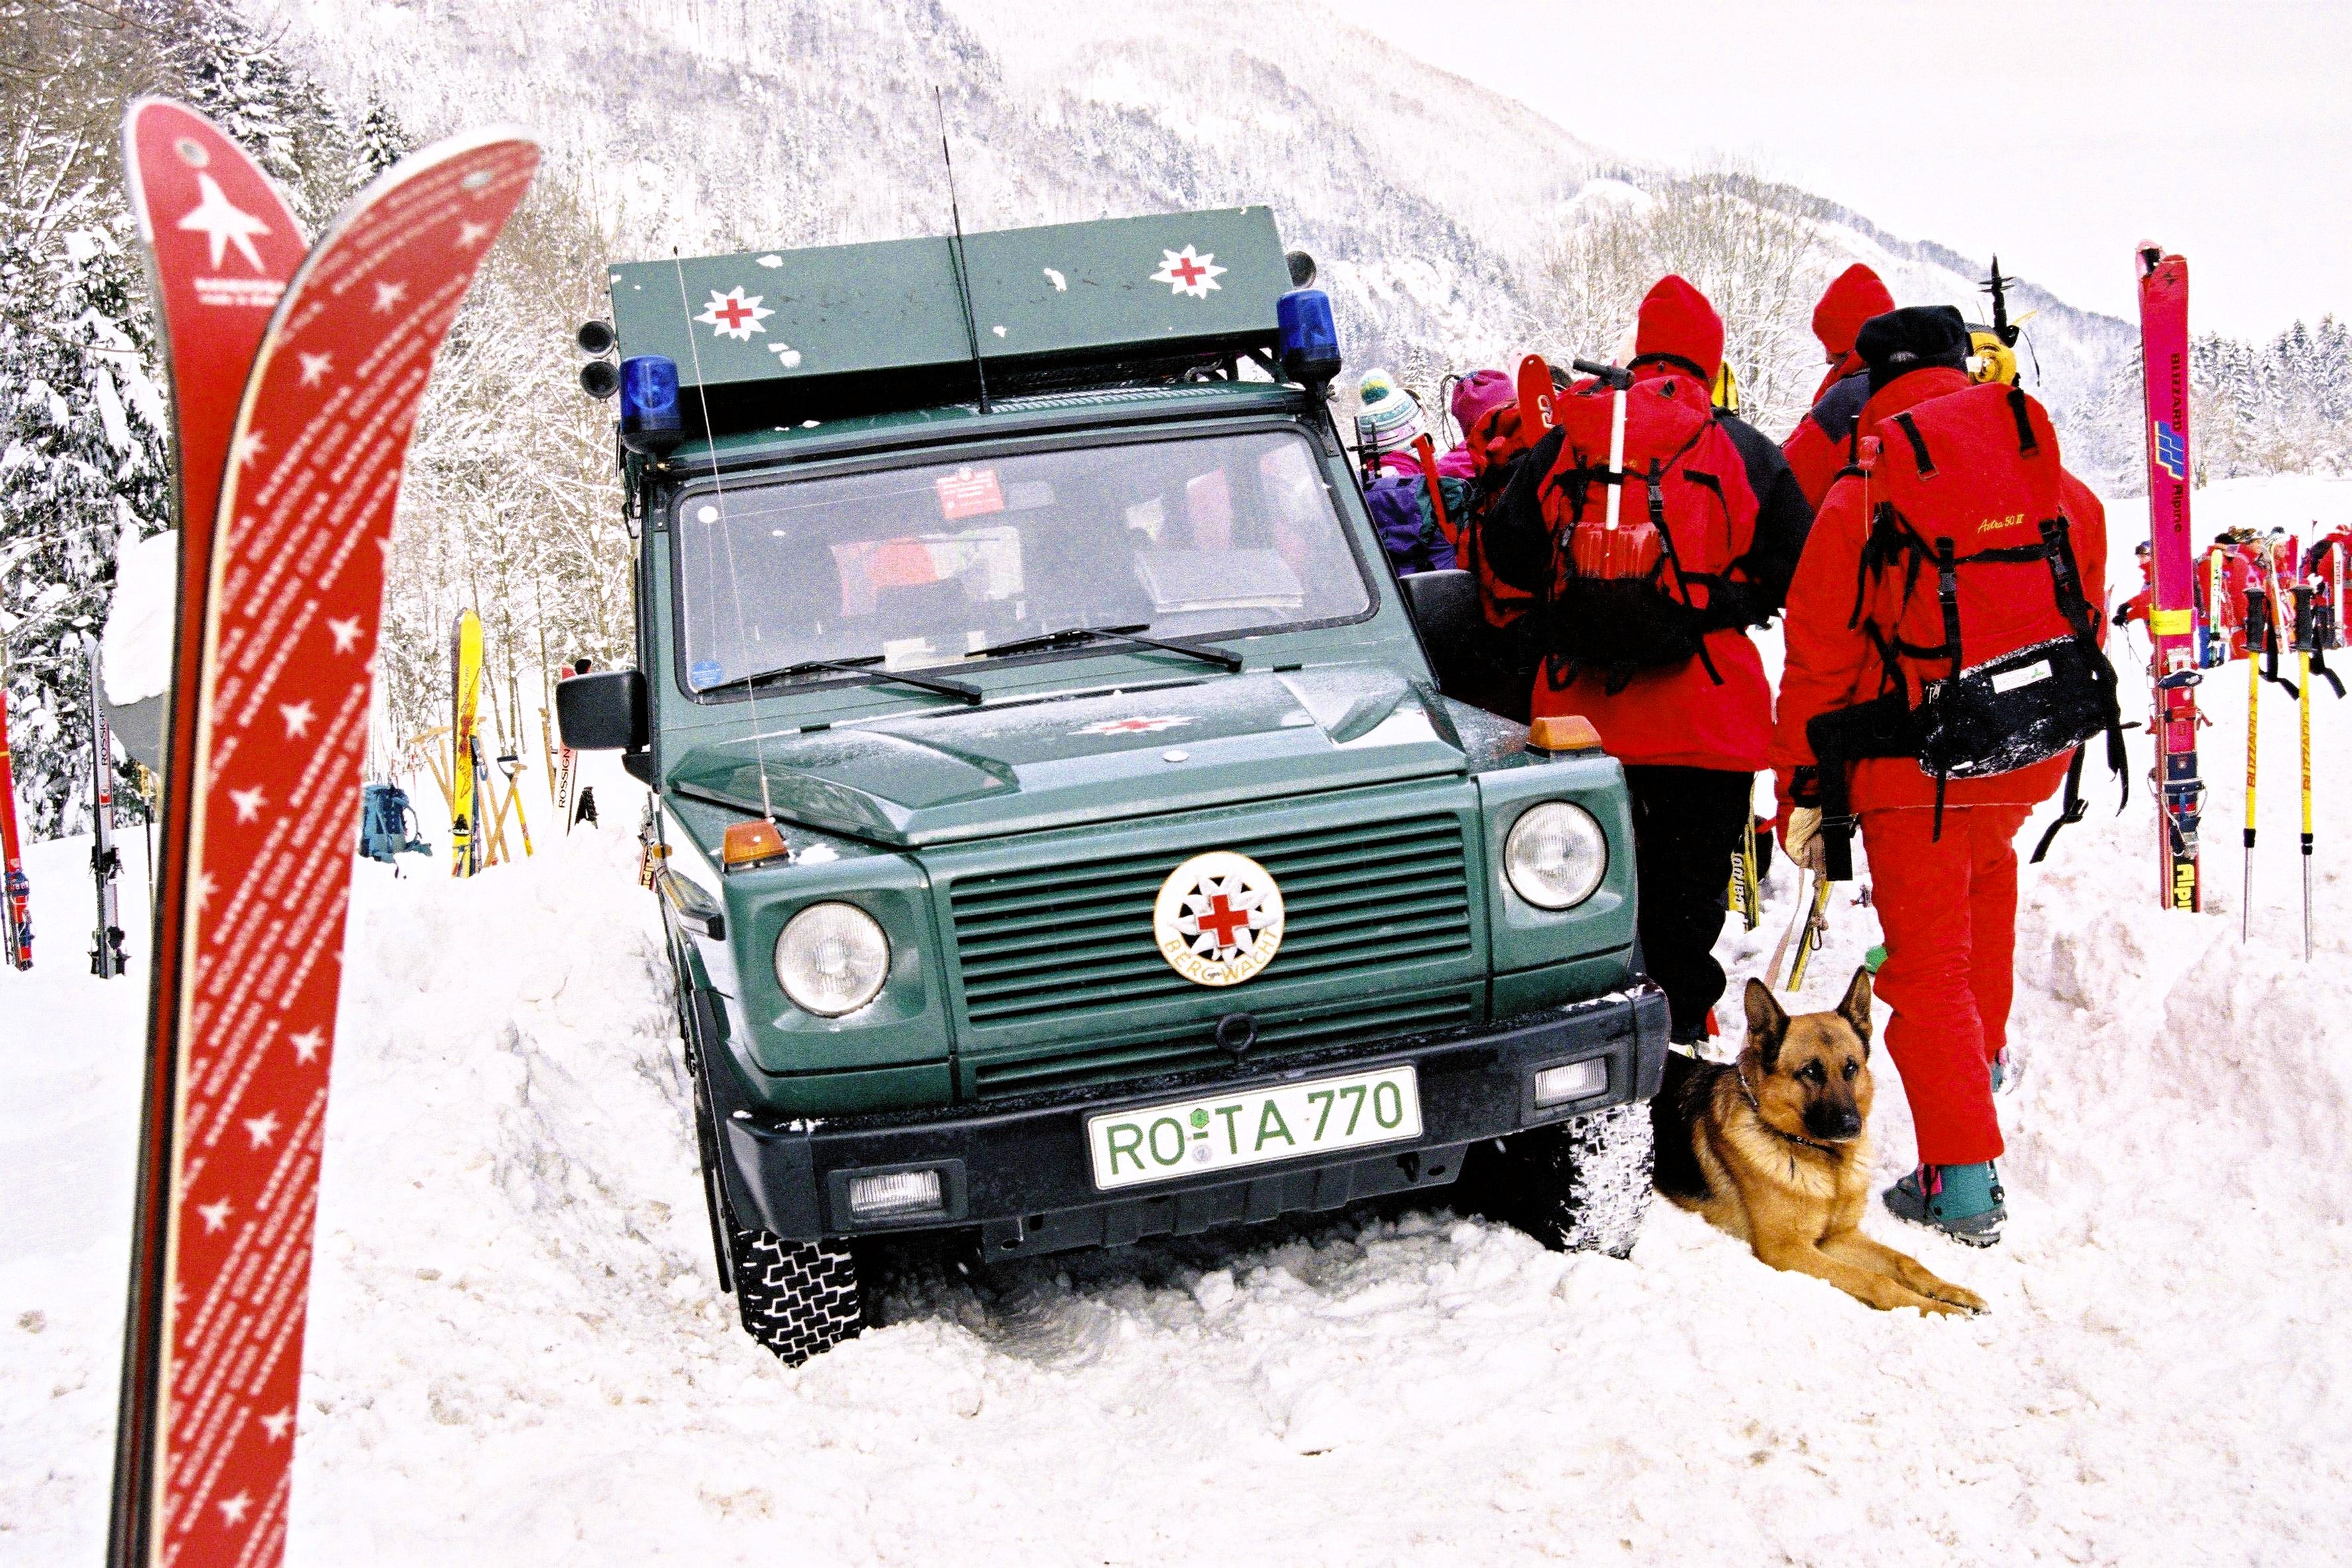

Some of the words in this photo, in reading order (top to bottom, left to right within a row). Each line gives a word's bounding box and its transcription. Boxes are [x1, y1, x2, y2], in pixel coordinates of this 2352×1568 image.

[1977, 519, 2003, 534] Astra
[2005, 515, 2015, 527] 50
[2016, 514, 2025, 524] II
[2171, 484, 2184, 532] Alpine
[558, 748, 571, 808] ROSSIGN
[2173, 864, 2195, 911] Alpi
[1164, 930, 1279, 982] BERGWACHT
[1307, 1081, 1403, 1141] 770
